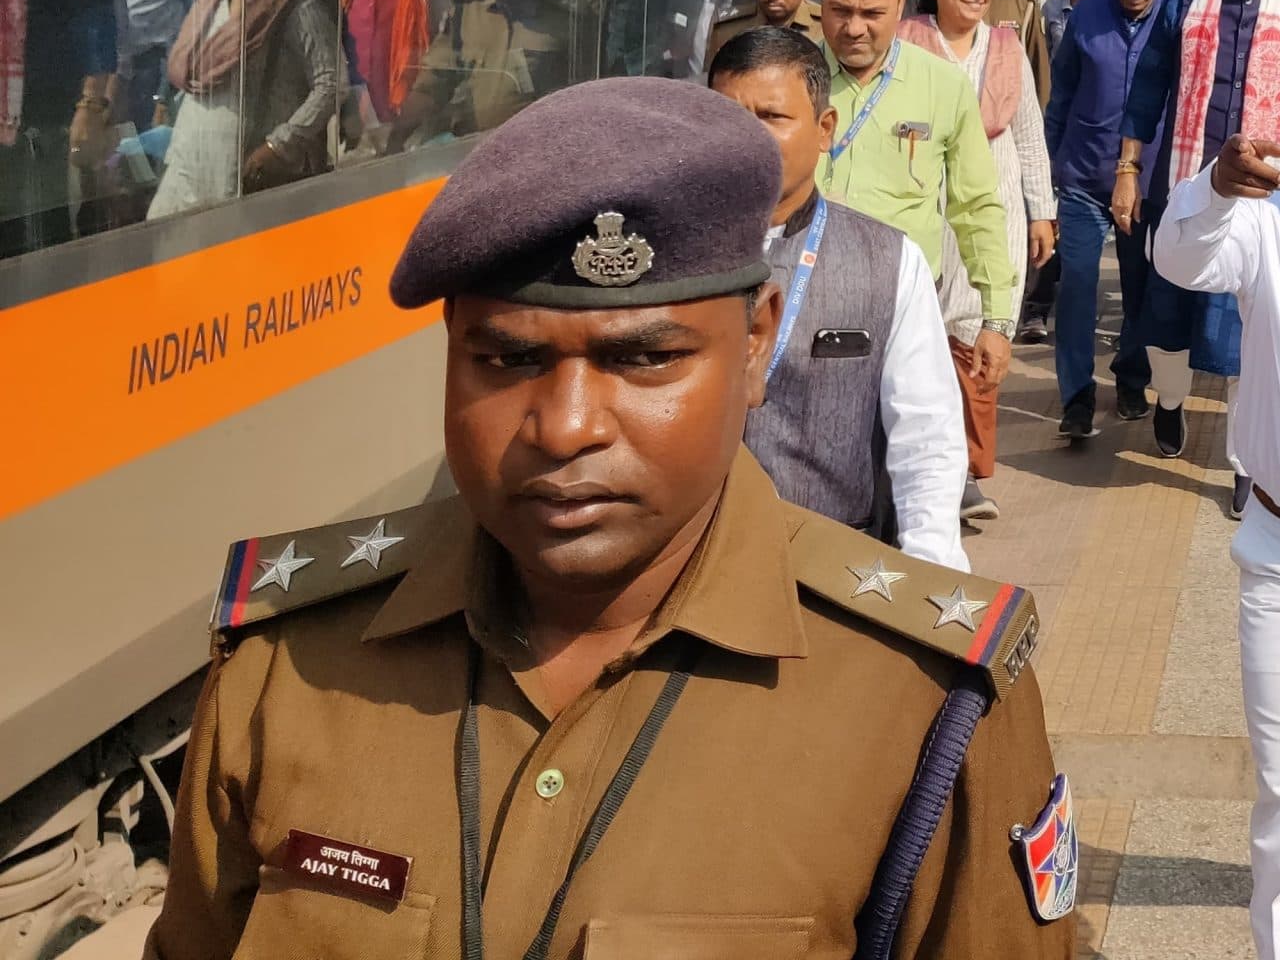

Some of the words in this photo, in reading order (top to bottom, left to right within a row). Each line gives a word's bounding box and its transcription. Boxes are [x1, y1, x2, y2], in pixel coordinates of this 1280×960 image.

[128, 312, 229, 395] INDIAN
[243, 266, 362, 349] RAILWAYS
[320, 846, 350, 863] अजय
[300, 858, 338, 877] AJAY
[341, 867, 390, 890] TIGGA
